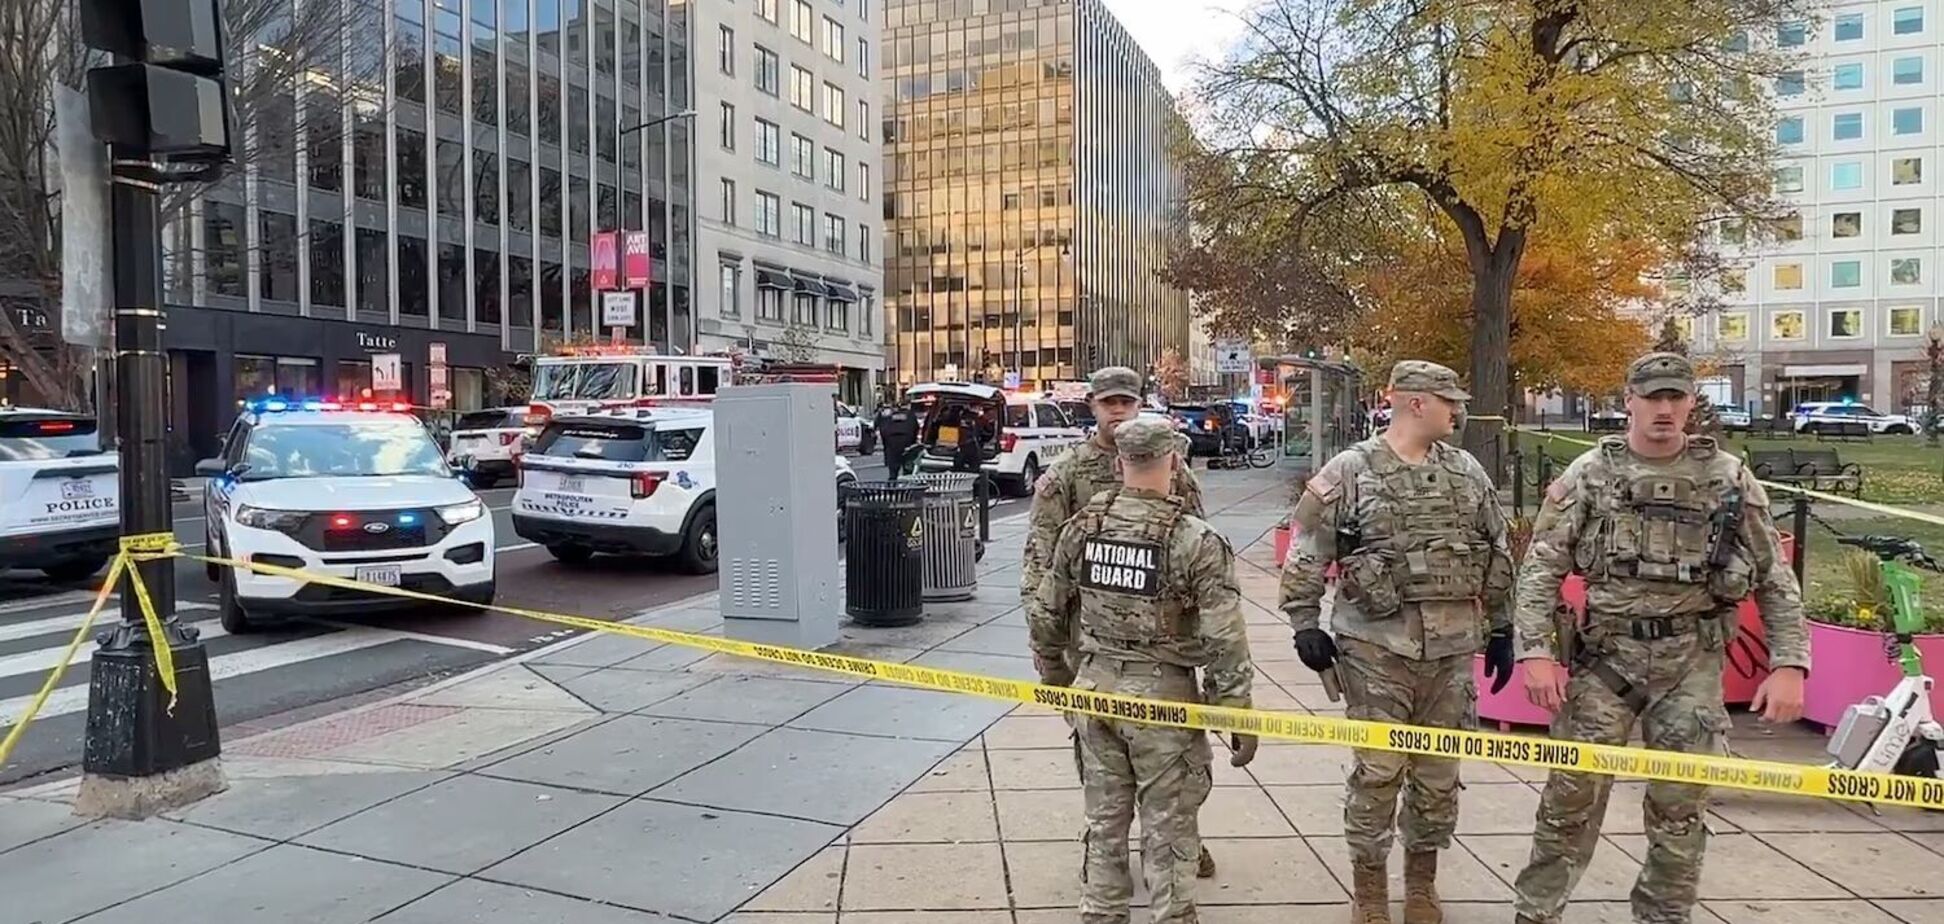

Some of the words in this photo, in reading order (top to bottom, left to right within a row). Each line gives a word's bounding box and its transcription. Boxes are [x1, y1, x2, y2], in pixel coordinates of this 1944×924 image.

[627, 234, 648, 245] ART
[627, 244, 648, 256] AVE
[357, 333, 396, 348] Tatte
[46, 497, 114, 513] POLICE
[556, 500, 580, 509] POLICE
[1085, 542, 1156, 569] NATIONAL
[1090, 563, 1146, 590] GUARD
[753, 644, 784, 661] CROSS
[784, 649, 801, 664] NOT
[802, 651, 816, 666] DO
[817, 654, 845, 671] SCENE
[846, 658, 877, 676] CRIME
[1033, 686, 1068, 708] CROSS
[1070, 691, 1091, 711] NOT
[1094, 694, 1108, 714] DO
[1111, 696, 1146, 719] SCENE
[1149, 701, 1187, 725] CRIME
[1388, 726, 1431, 752] CROSS
[1434, 731, 1460, 755] NOT
[1464, 734, 1482, 757] DO
[1487, 736, 1530, 762] SCENE
[1533, 741, 1579, 768] CRIME
[1591, 751, 1638, 774] CROSS
[1642, 756, 1671, 778] NOT
[1675, 759, 1696, 780] DO
[1700, 762, 1748, 786] SCENE
[1752, 767, 1803, 792] CRIME
[1827, 769, 1881, 800] CROSS
[1883, 777, 1917, 804] NOT
[1921, 782, 1944, 808] DO
